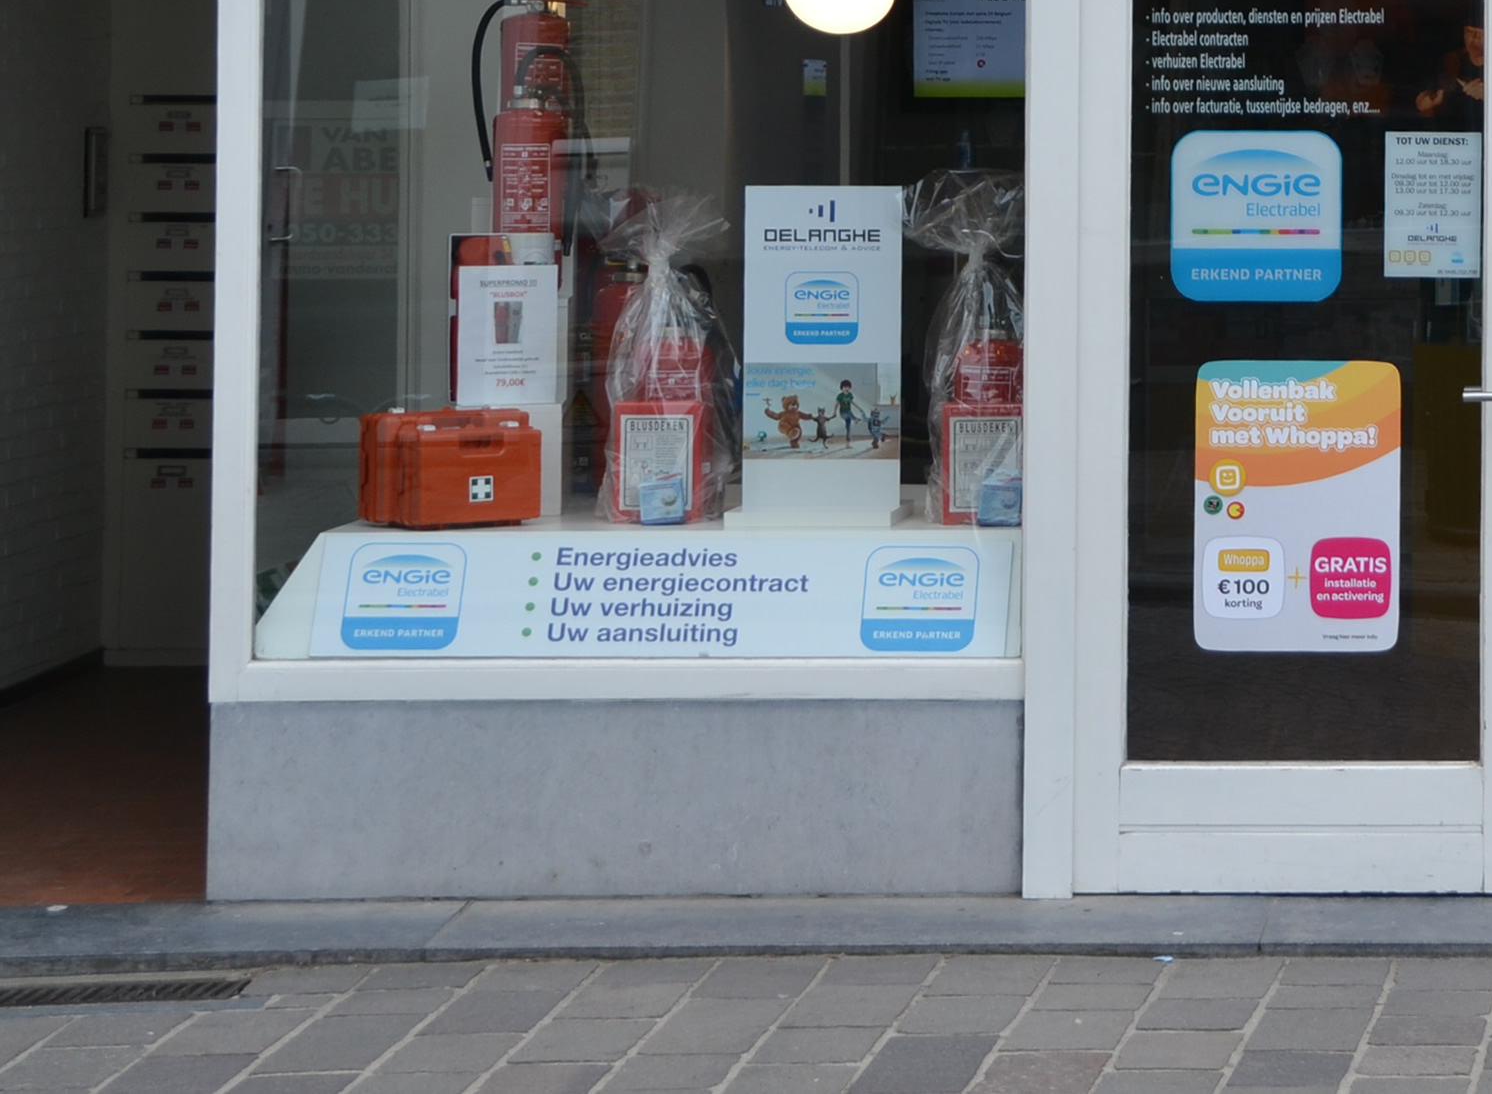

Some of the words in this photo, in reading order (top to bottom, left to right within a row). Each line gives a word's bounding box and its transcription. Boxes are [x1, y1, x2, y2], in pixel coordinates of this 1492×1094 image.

[1152, 9, 1170, 24] info
[1173, 12, 1194, 24] over
[1196, 9, 1247, 26] producten,
[1248, 9, 1288, 24] diensten
[1290, 13, 1302, 24] en
[1305, 9, 1337, 27] prijzen
[1339, 9, 1384, 24] Electrabel
[1152, 31, 1197, 46] Electrabel
[1199, 33, 1248, 46] contracten
[1152, 54, 1198, 69] verhuizen
[1200, 54, 1245, 69] Electrabel
[1152, 76, 1170, 91] info
[1173, 80, 1194, 91] over
[1196, 77, 1231, 91] nieuwe
[1233, 76, 1284, 95] aansluiting
[1152, 99, 1170, 114] info
[1173, 102, 1194, 114] over
[1196, 99, 1243, 116] facturatie,
[1246, 99, 1301, 117] tussentijdse
[1303, 99, 1350, 117] bedragen,
[1396, 137, 1412, 145] TOT
[1415, 137, 1431, 145] UW
[1433, 137, 1469, 146] DIENST:
[1246, 203, 1321, 217] Electrabel
[764, 228, 881, 242] DELANGHE
[1192, 268, 1250, 280] ERKEND
[1255, 268, 1322, 281] PARTNER
[1212, 379, 1336, 400] Vollenbak
[1211, 403, 1306, 423] Vooruit
[630, 420, 684, 431] BLUSDEKEN
[1211, 426, 1262, 445] met
[1265, 425, 1378, 451] Whoppa!
[555, 547, 738, 571] Energieadvies
[1223, 553, 1264, 567] Whoppa
[1314, 557, 1387, 573] GRATIS
[553, 572, 595, 592] Uw
[602, 573, 809, 596] energiecontract
[1324, 578, 1377, 588] installatie
[397, 587, 449, 598] Electrabel
[913, 590, 963, 600] Electrabel
[1316, 592, 1330, 601] en
[1331, 590, 1384, 603] activering
[550, 597, 592, 617] Uw
[600, 598, 733, 621] verhuizing
[1224, 598, 1263, 610] korting
[353, 628, 395, 638] ERKEND
[397, 628, 444, 638] PARTNER
[547, 622, 589, 642] Uw
[596, 623, 738, 647] aansluiting
[873, 630, 913, 639] ERKEND
[916, 630, 961, 639] PARTNER
